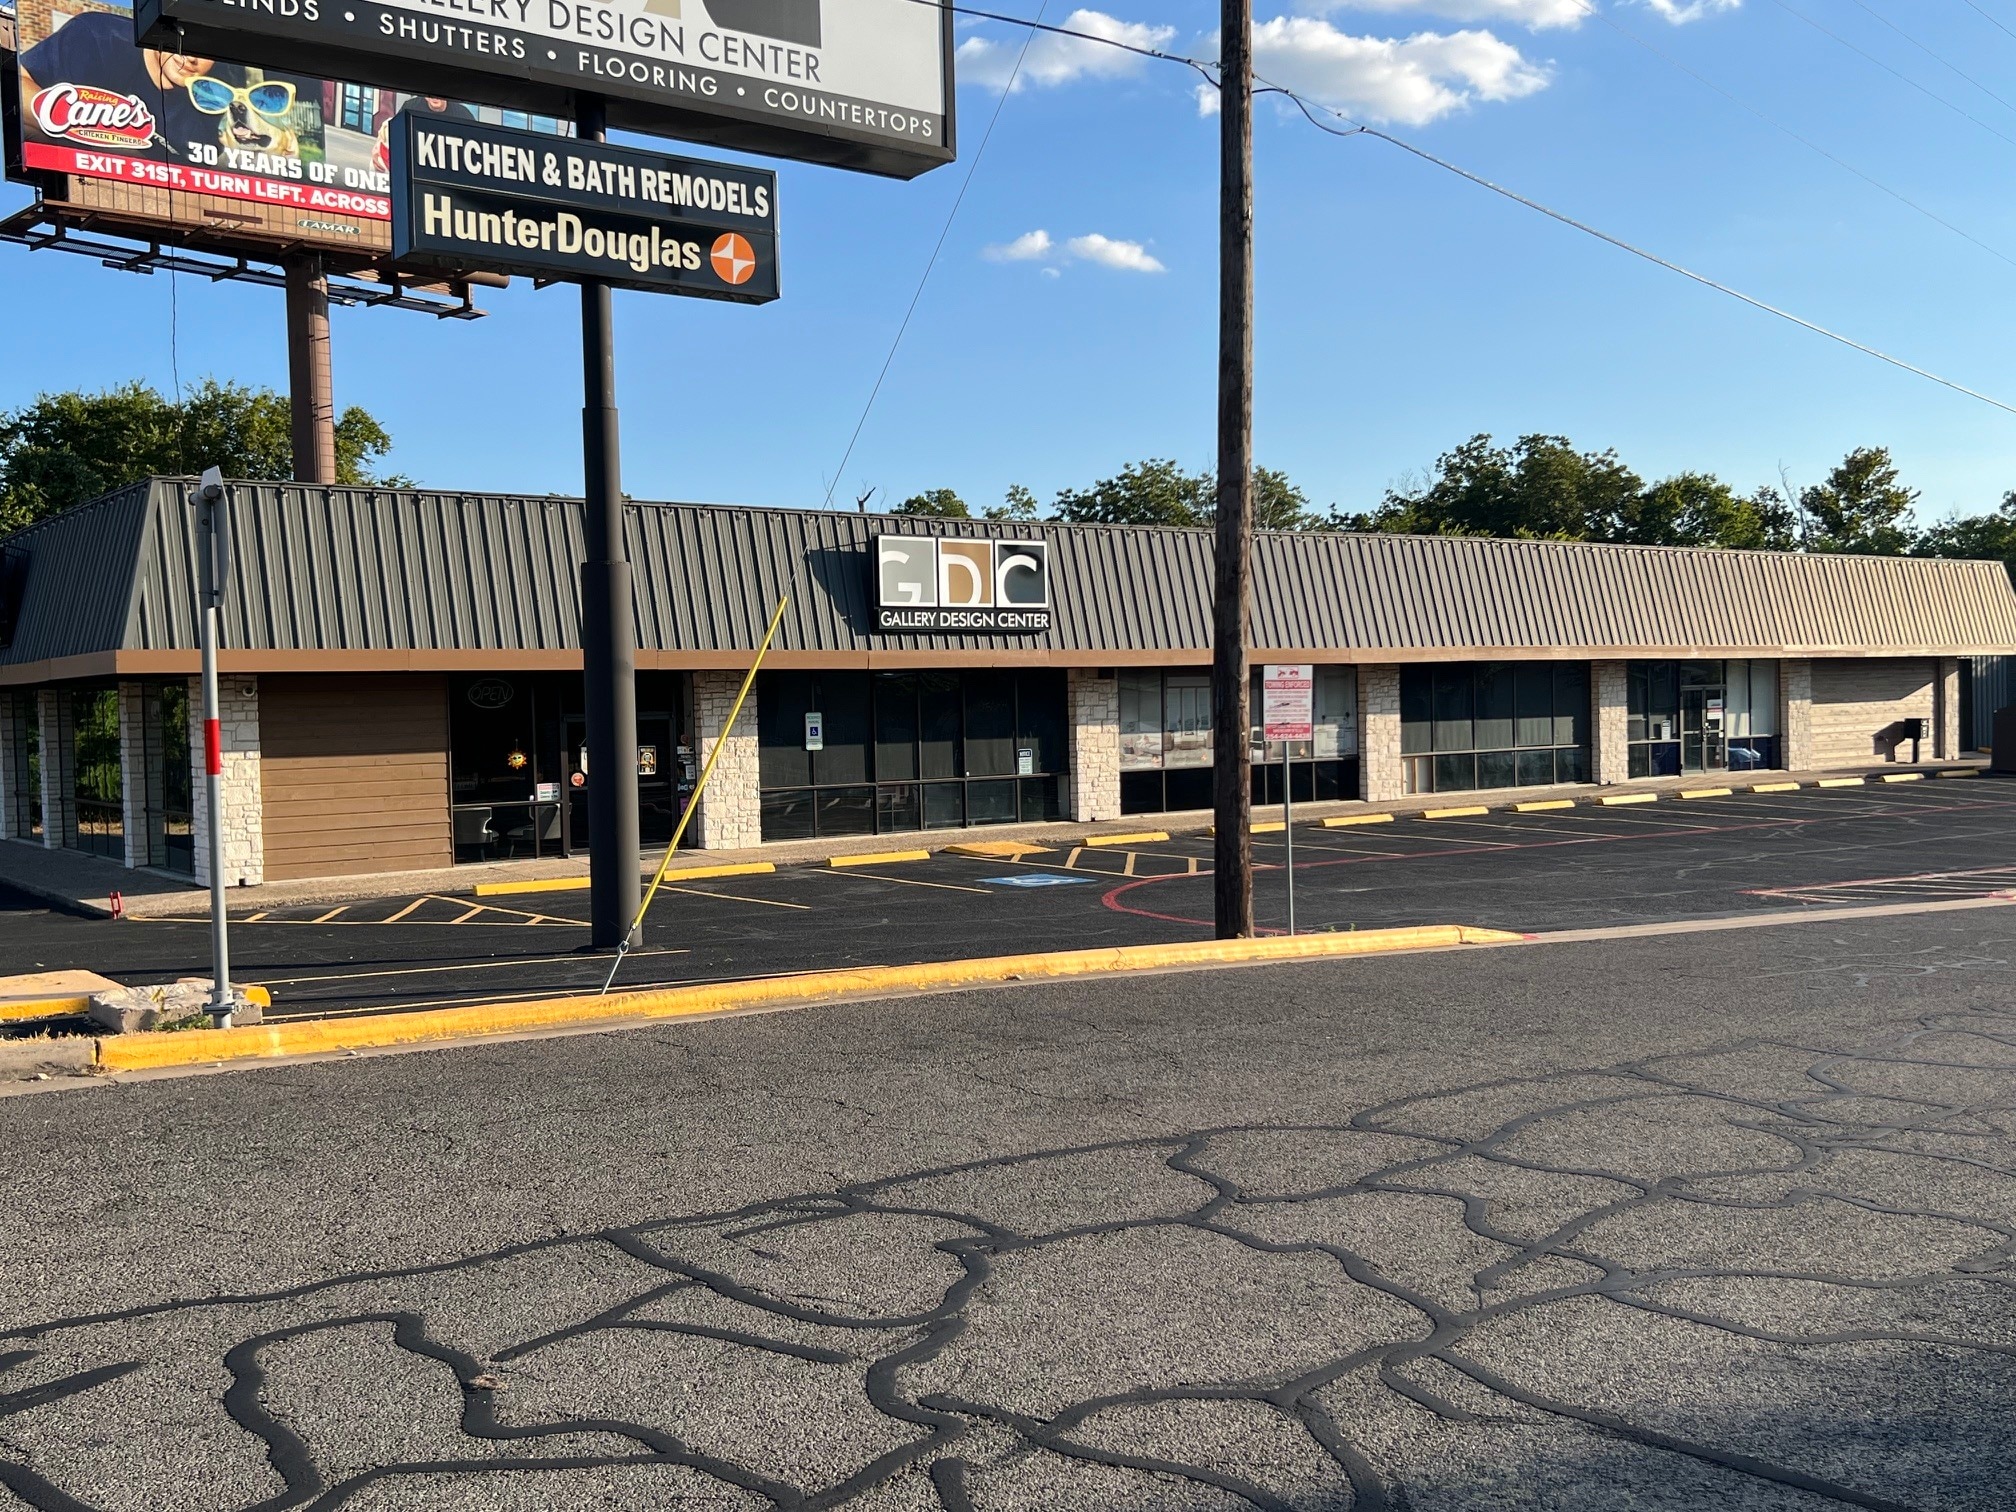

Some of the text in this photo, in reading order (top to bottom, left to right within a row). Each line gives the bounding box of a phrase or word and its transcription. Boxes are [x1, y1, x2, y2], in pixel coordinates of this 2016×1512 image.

[549, 1, 684, 56] DESIGN
[699, 32, 821, 82] CENTER
[79, 90, 118, 106] Raising
[380, 13, 526, 59] SHUTTERS
[579, 52, 717, 97] FLOORING
[764, 89, 932, 137] COUNTERTOPS
[39, 85, 153, 132] Cane's
[76, 153, 389, 215] EXIT 31ST, TURN LEFT. ACROSS
[188, 142, 390, 193] 30 YEARS OF ONE
[417, 131, 769, 218] KITCHEN & BATH REMODELS
[423, 193, 701, 272] HunterDouglas
[880, 611, 1049, 628] GALLERY DESIGN CENTER
[471, 686, 510, 701] OPEN
